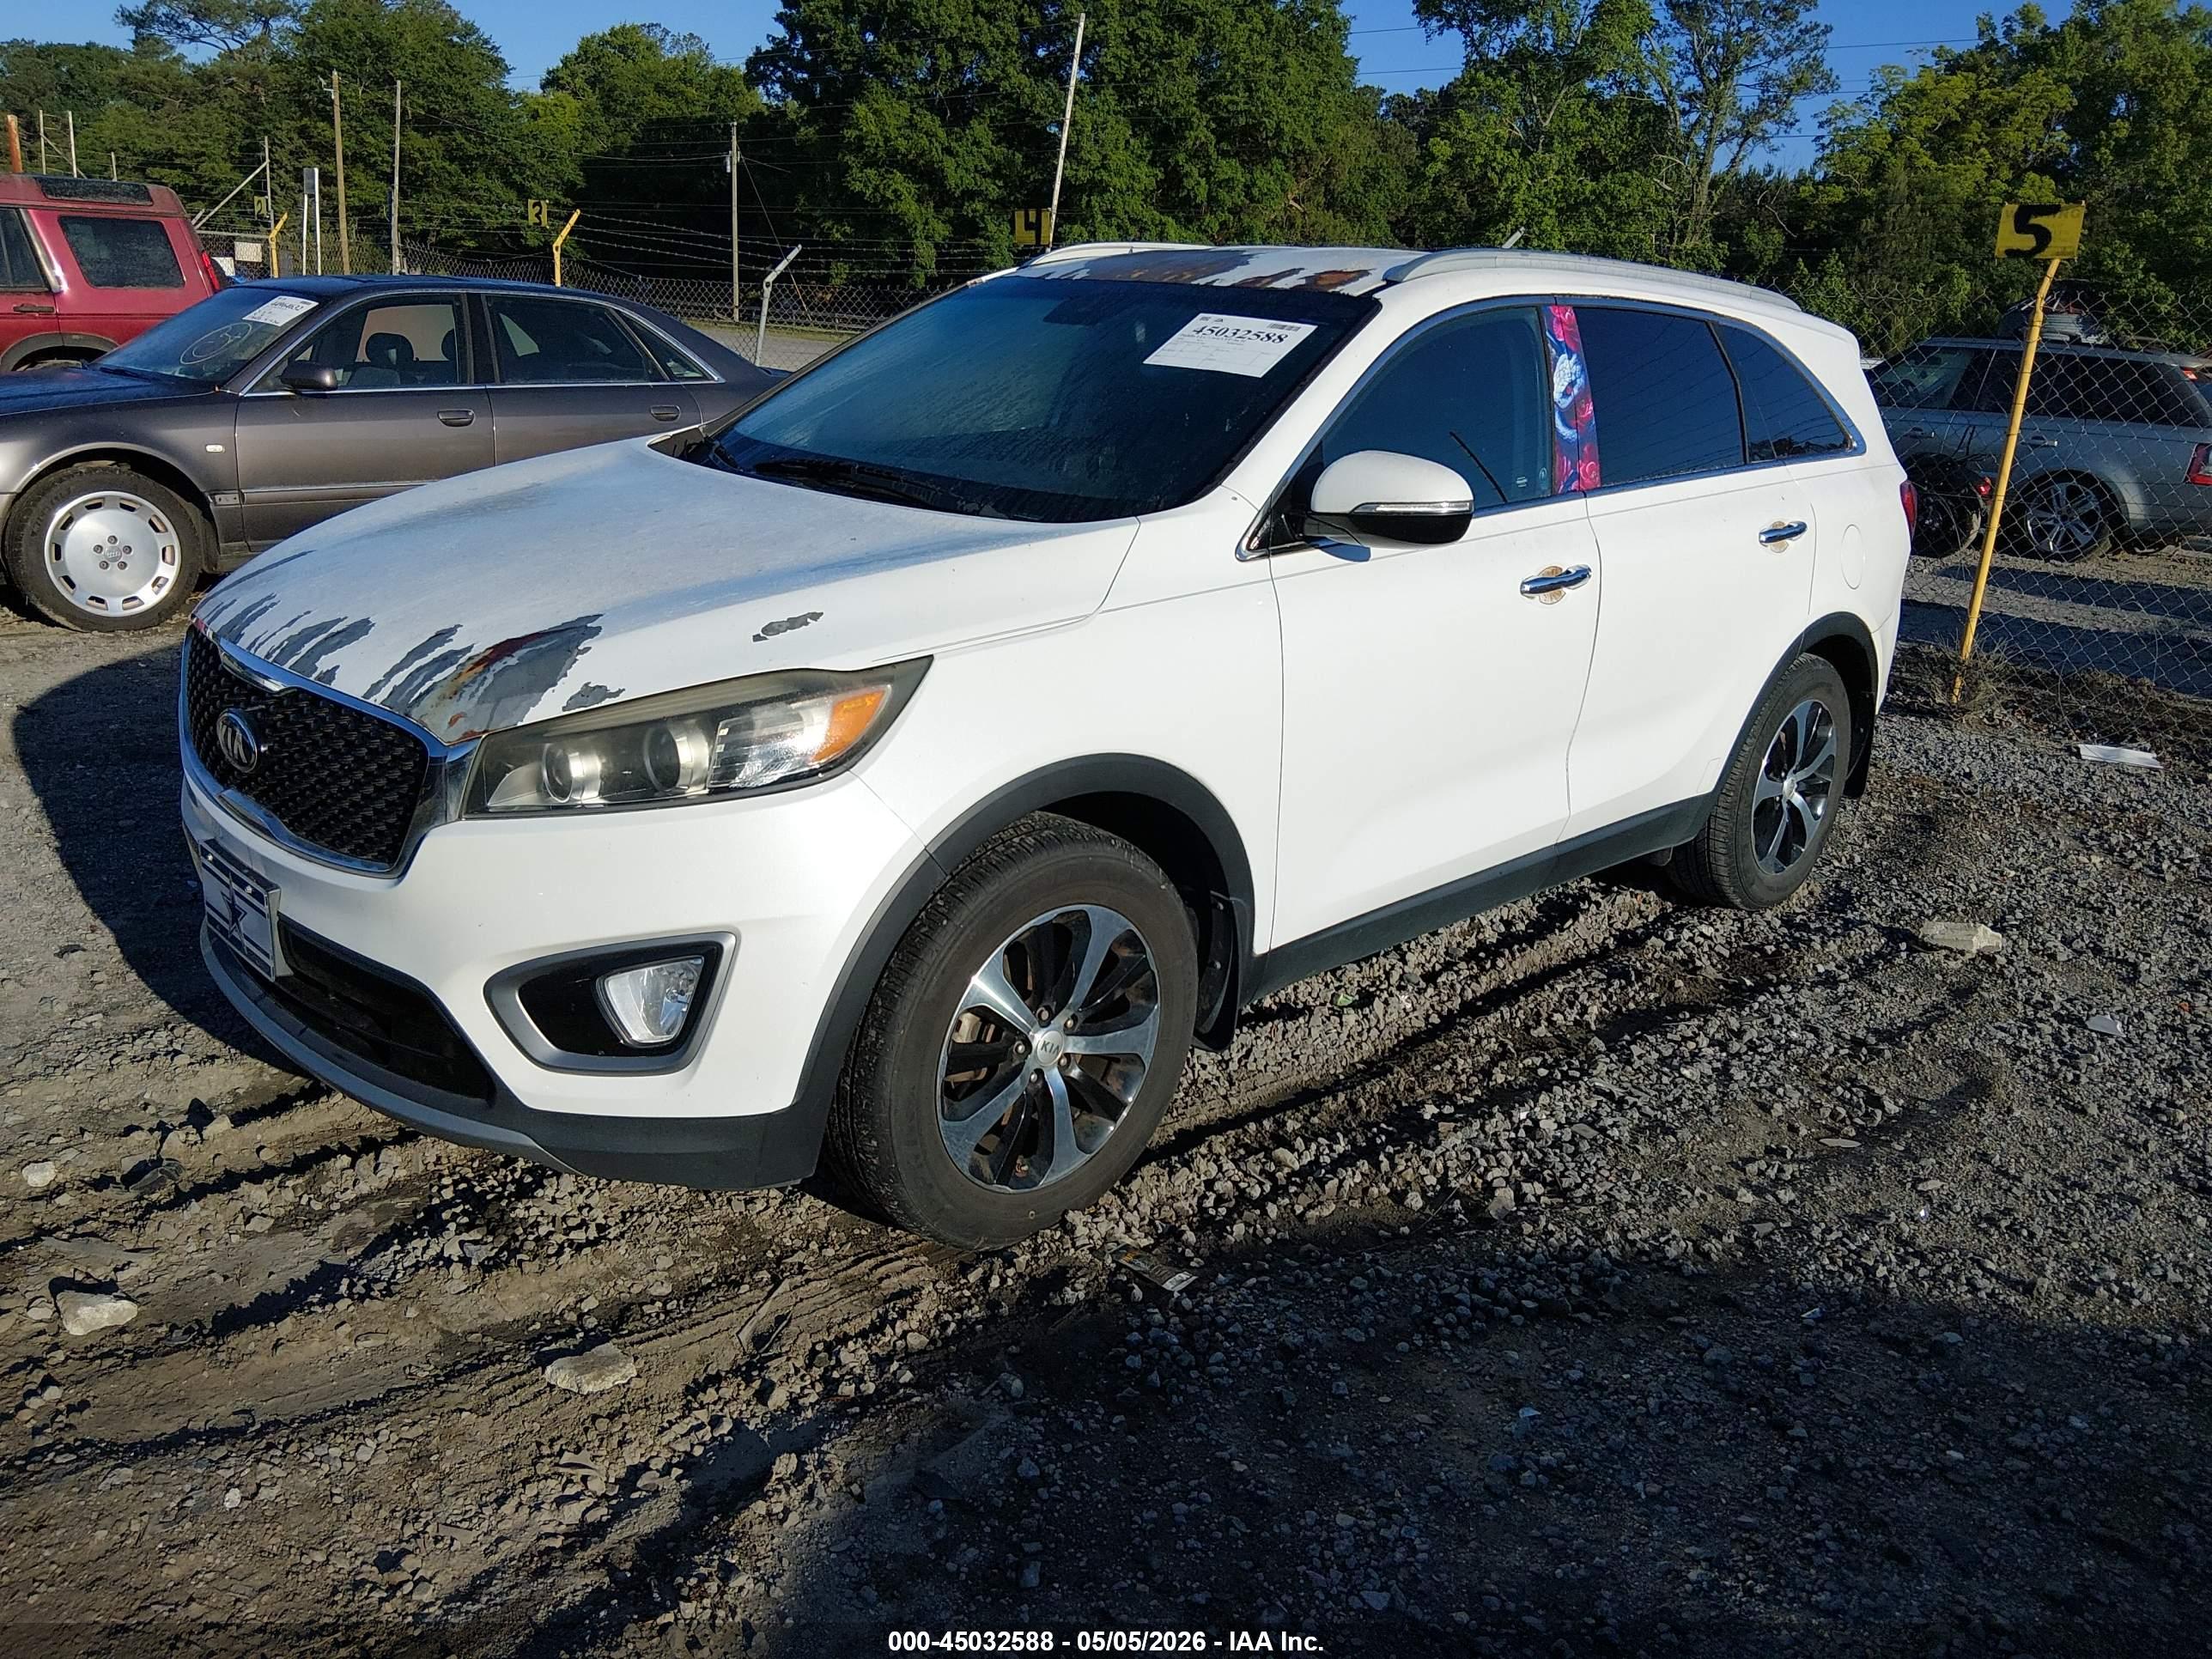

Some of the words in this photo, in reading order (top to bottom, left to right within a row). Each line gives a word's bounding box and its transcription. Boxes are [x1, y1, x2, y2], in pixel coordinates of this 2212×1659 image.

[532, 201, 543, 226] 3
[1024, 209, 1042, 246] 4
[2004, 204, 2062, 258] 5
[1193, 325, 1289, 344] 45032588
[219, 721, 248, 764] KIA
[1040, 1040, 1060, 1056] KIA
